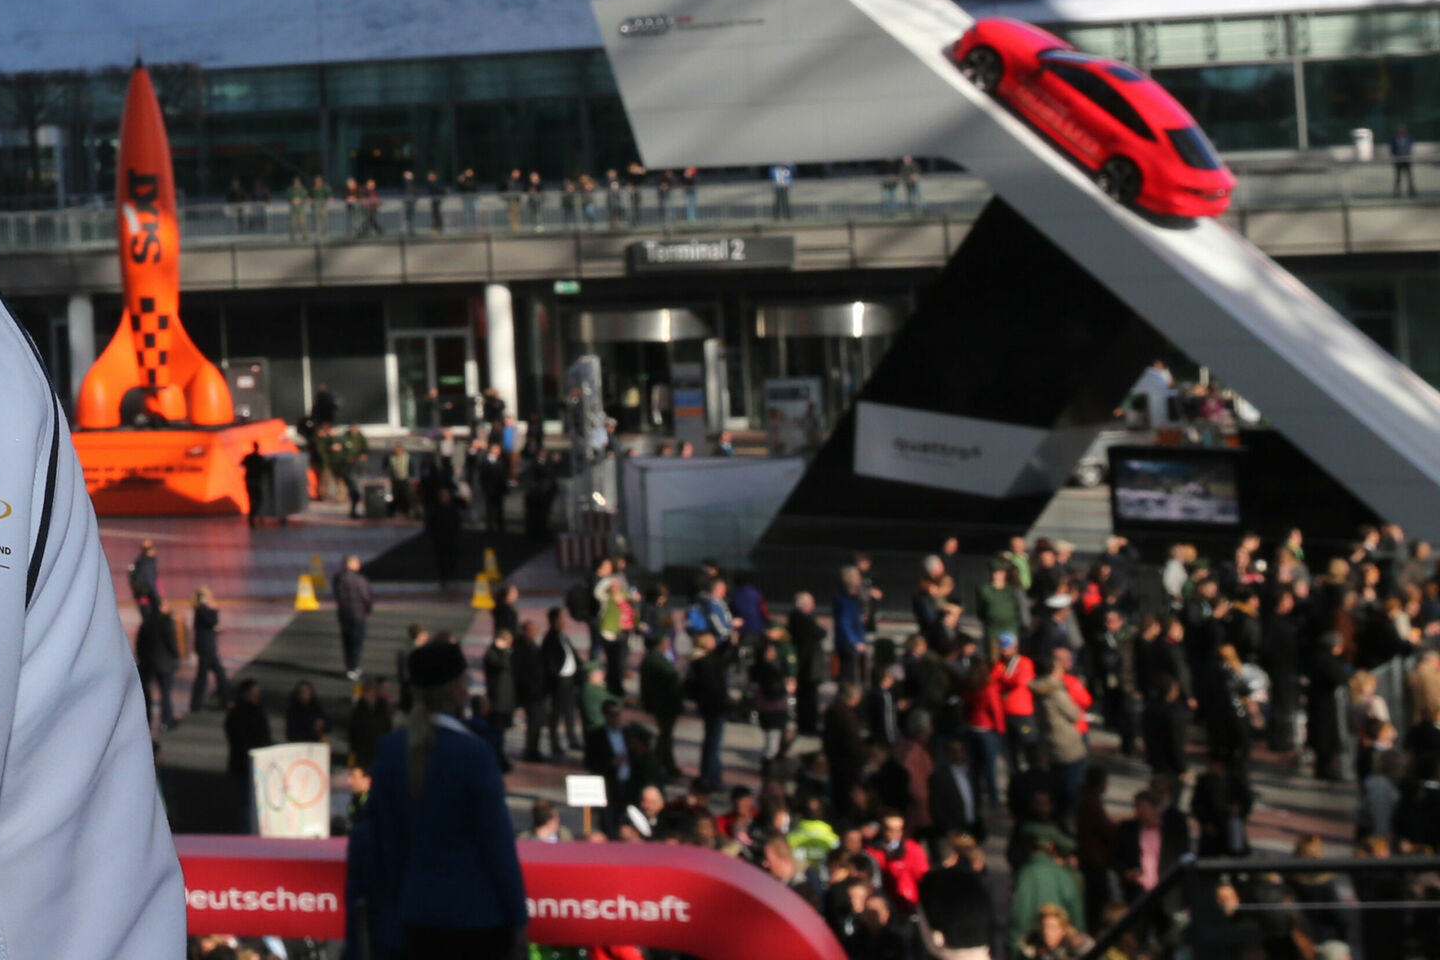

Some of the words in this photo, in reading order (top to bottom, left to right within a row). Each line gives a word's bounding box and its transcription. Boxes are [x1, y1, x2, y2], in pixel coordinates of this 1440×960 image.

[643, 239, 728, 262] Terminal
[730, 238, 746, 261] 2
[185, 886, 338, 913] eutschen
[525, 894, 691, 922] annschaft
